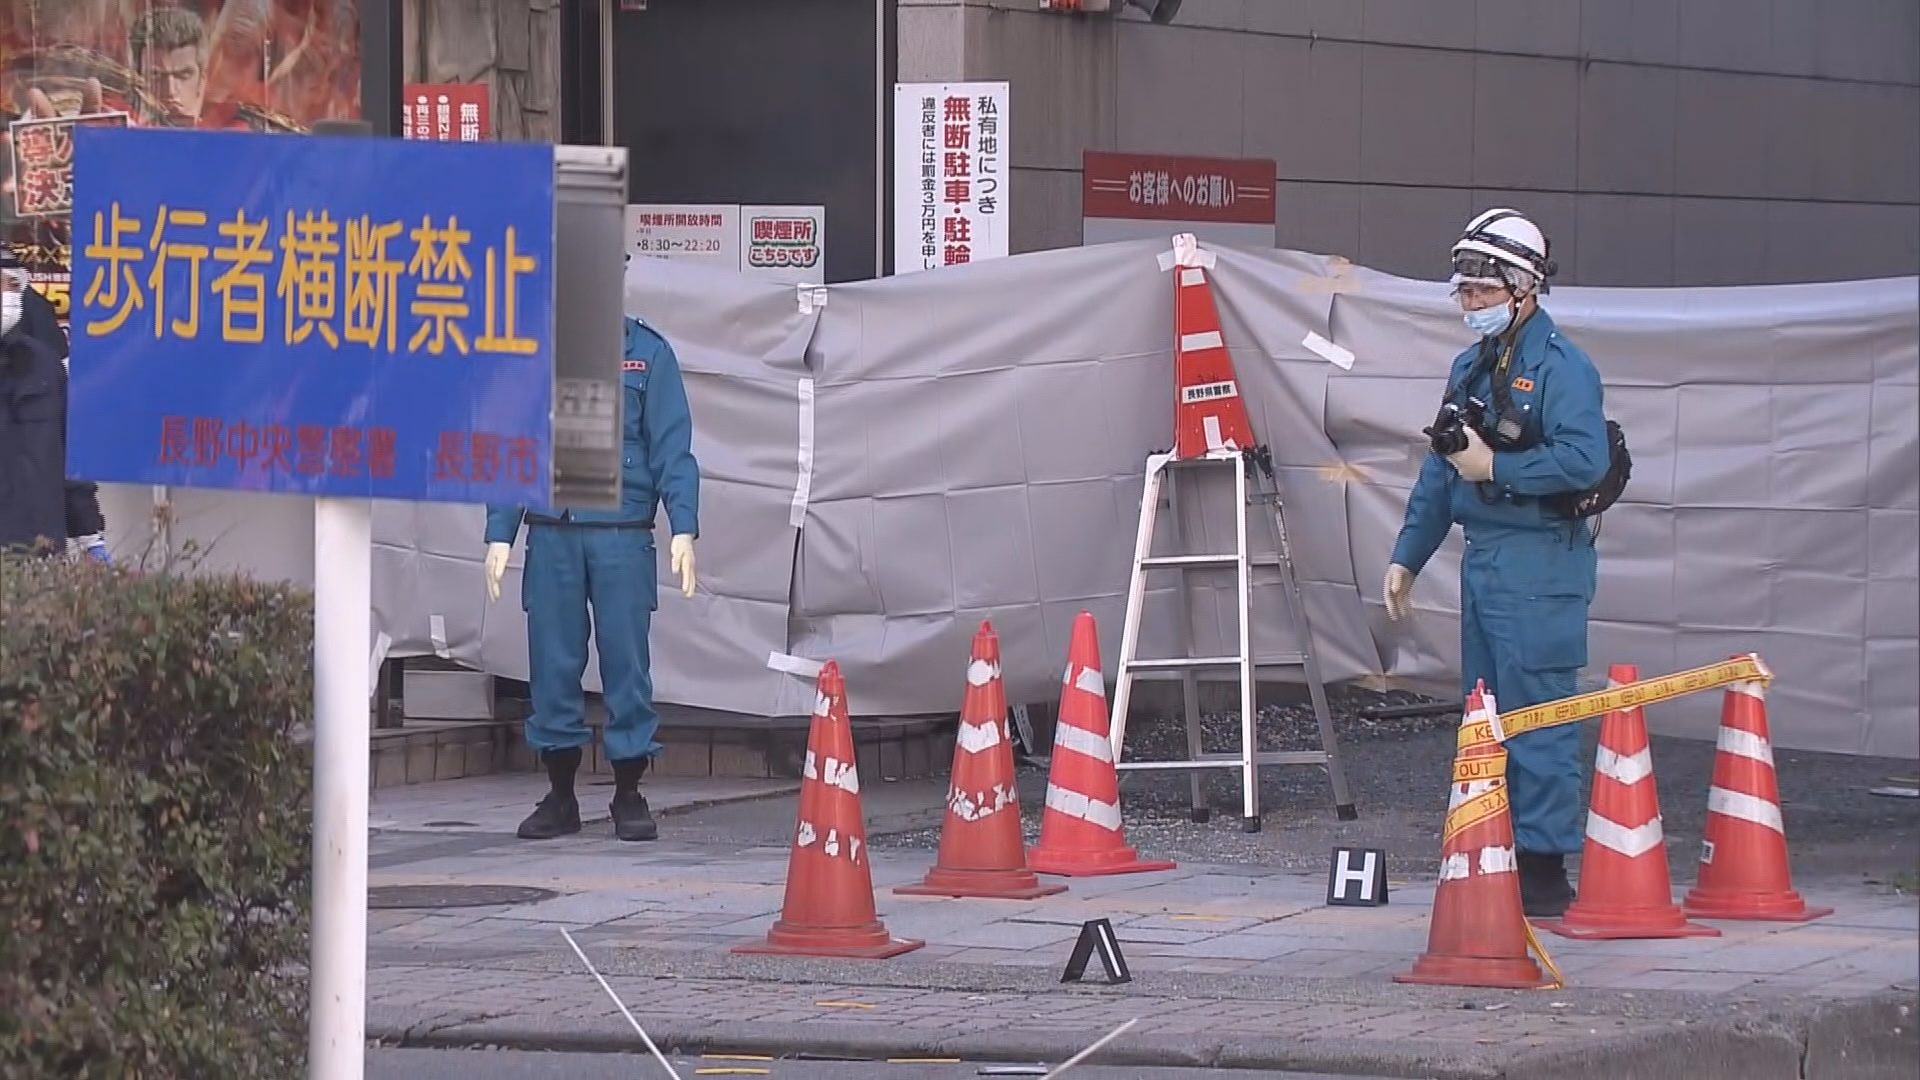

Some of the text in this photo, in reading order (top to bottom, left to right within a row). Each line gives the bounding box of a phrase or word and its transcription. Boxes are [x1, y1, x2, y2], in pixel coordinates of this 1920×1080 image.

[461, 103, 479, 142] 無断
[977, 96, 998, 214] 私有地につき
[943, 95, 971, 267] 無断駐車・駐輪
[1129, 169, 1235, 208] お客様へのお願い
[753, 220, 812, 241] 喫煙所
[751, 247, 815, 262] こちらです
[84, 202, 538, 356] 歩行者横断禁止
[159, 415, 539, 484] 長野中央警察署 長野市
[1460, 761, 1492, 777] OUT
[1334, 850, 1377, 900] H
